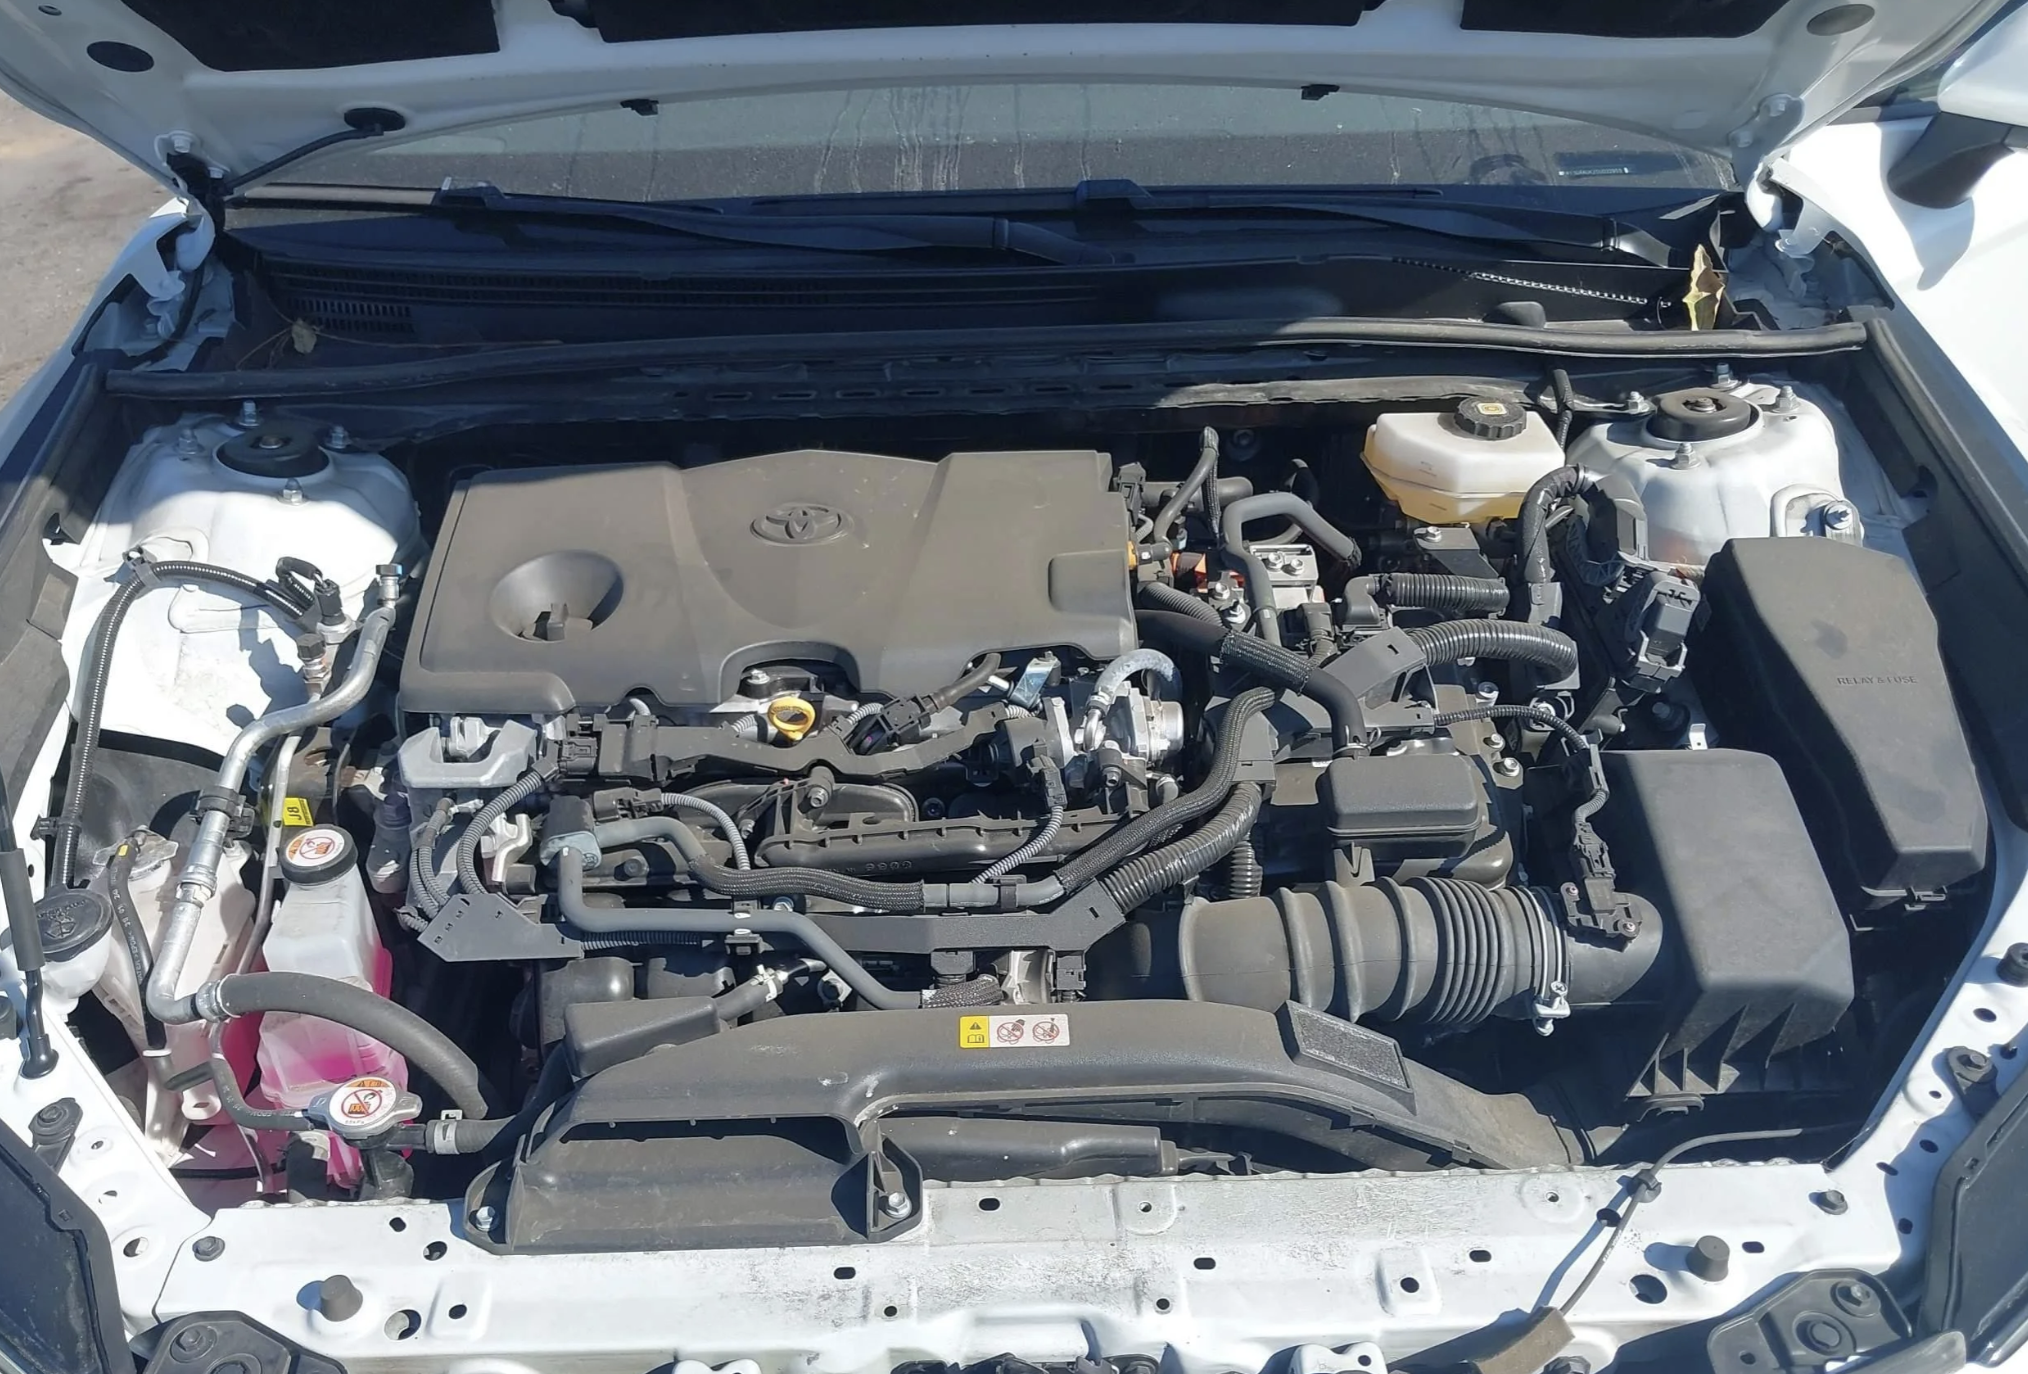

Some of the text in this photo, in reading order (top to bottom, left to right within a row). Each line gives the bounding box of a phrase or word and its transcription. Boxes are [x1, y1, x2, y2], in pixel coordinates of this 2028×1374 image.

[1836, 677, 1874, 685] RELAY
[1886, 676, 1918, 684] FUSE
[287, 806, 302, 820] J8
